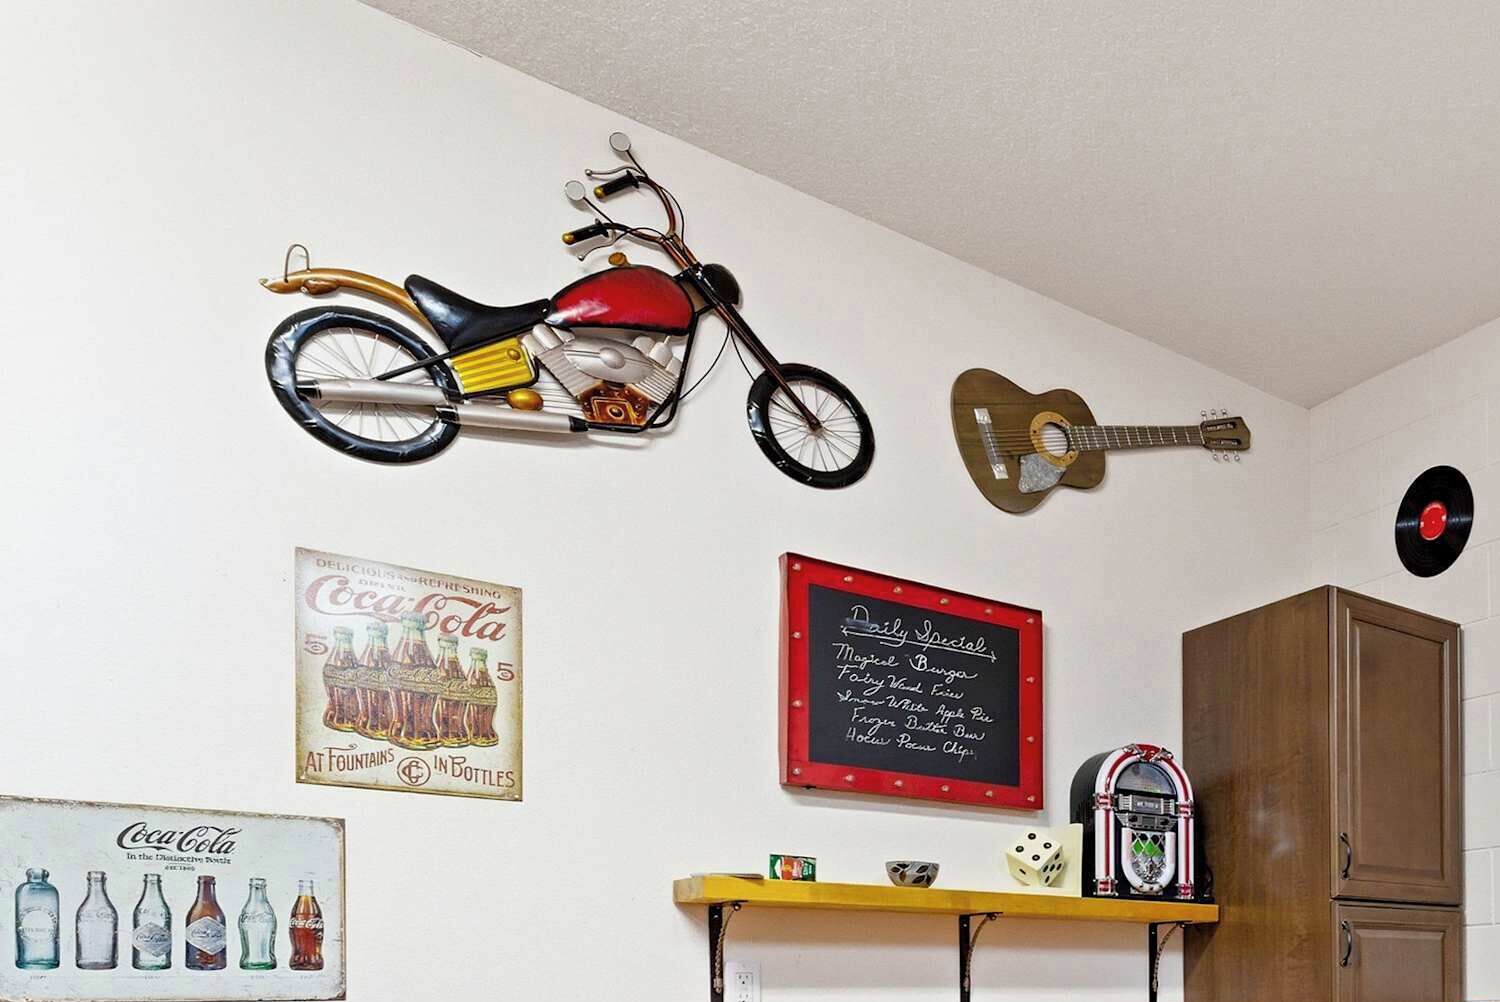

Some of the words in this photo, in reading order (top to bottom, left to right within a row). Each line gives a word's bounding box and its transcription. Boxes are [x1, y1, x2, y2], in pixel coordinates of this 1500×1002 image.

[316, 558, 396, 581] DELICIOUS
[419, 576, 502, 600] REFRESHING
[304, 575, 512, 642] Coca-Cola
[847, 605, 909, 647] Daily
[832, 643, 900, 669] Magical
[837, 664, 885, 696] Fairy
[887, 675, 924, 694] Wand
[837, 689, 885, 704] Snow
[886, 695, 929, 713] White
[936, 704, 965, 724] Apple
[969, 706, 995, 723] Pie
[851, 706, 897, 737] Frozen
[845, 728, 892, 746] Hocus
[896, 733, 937, 752] Pocus
[306, 750, 324, 773] AT
[324, 744, 395, 773] FOUNTAINS
[434, 755, 448, 774] IN
[449, 755, 516, 788] BOTTLES
[116, 821, 242, 854] Coca-Cola
[127, 852, 137, 860] In
[138, 852, 153, 861] the
